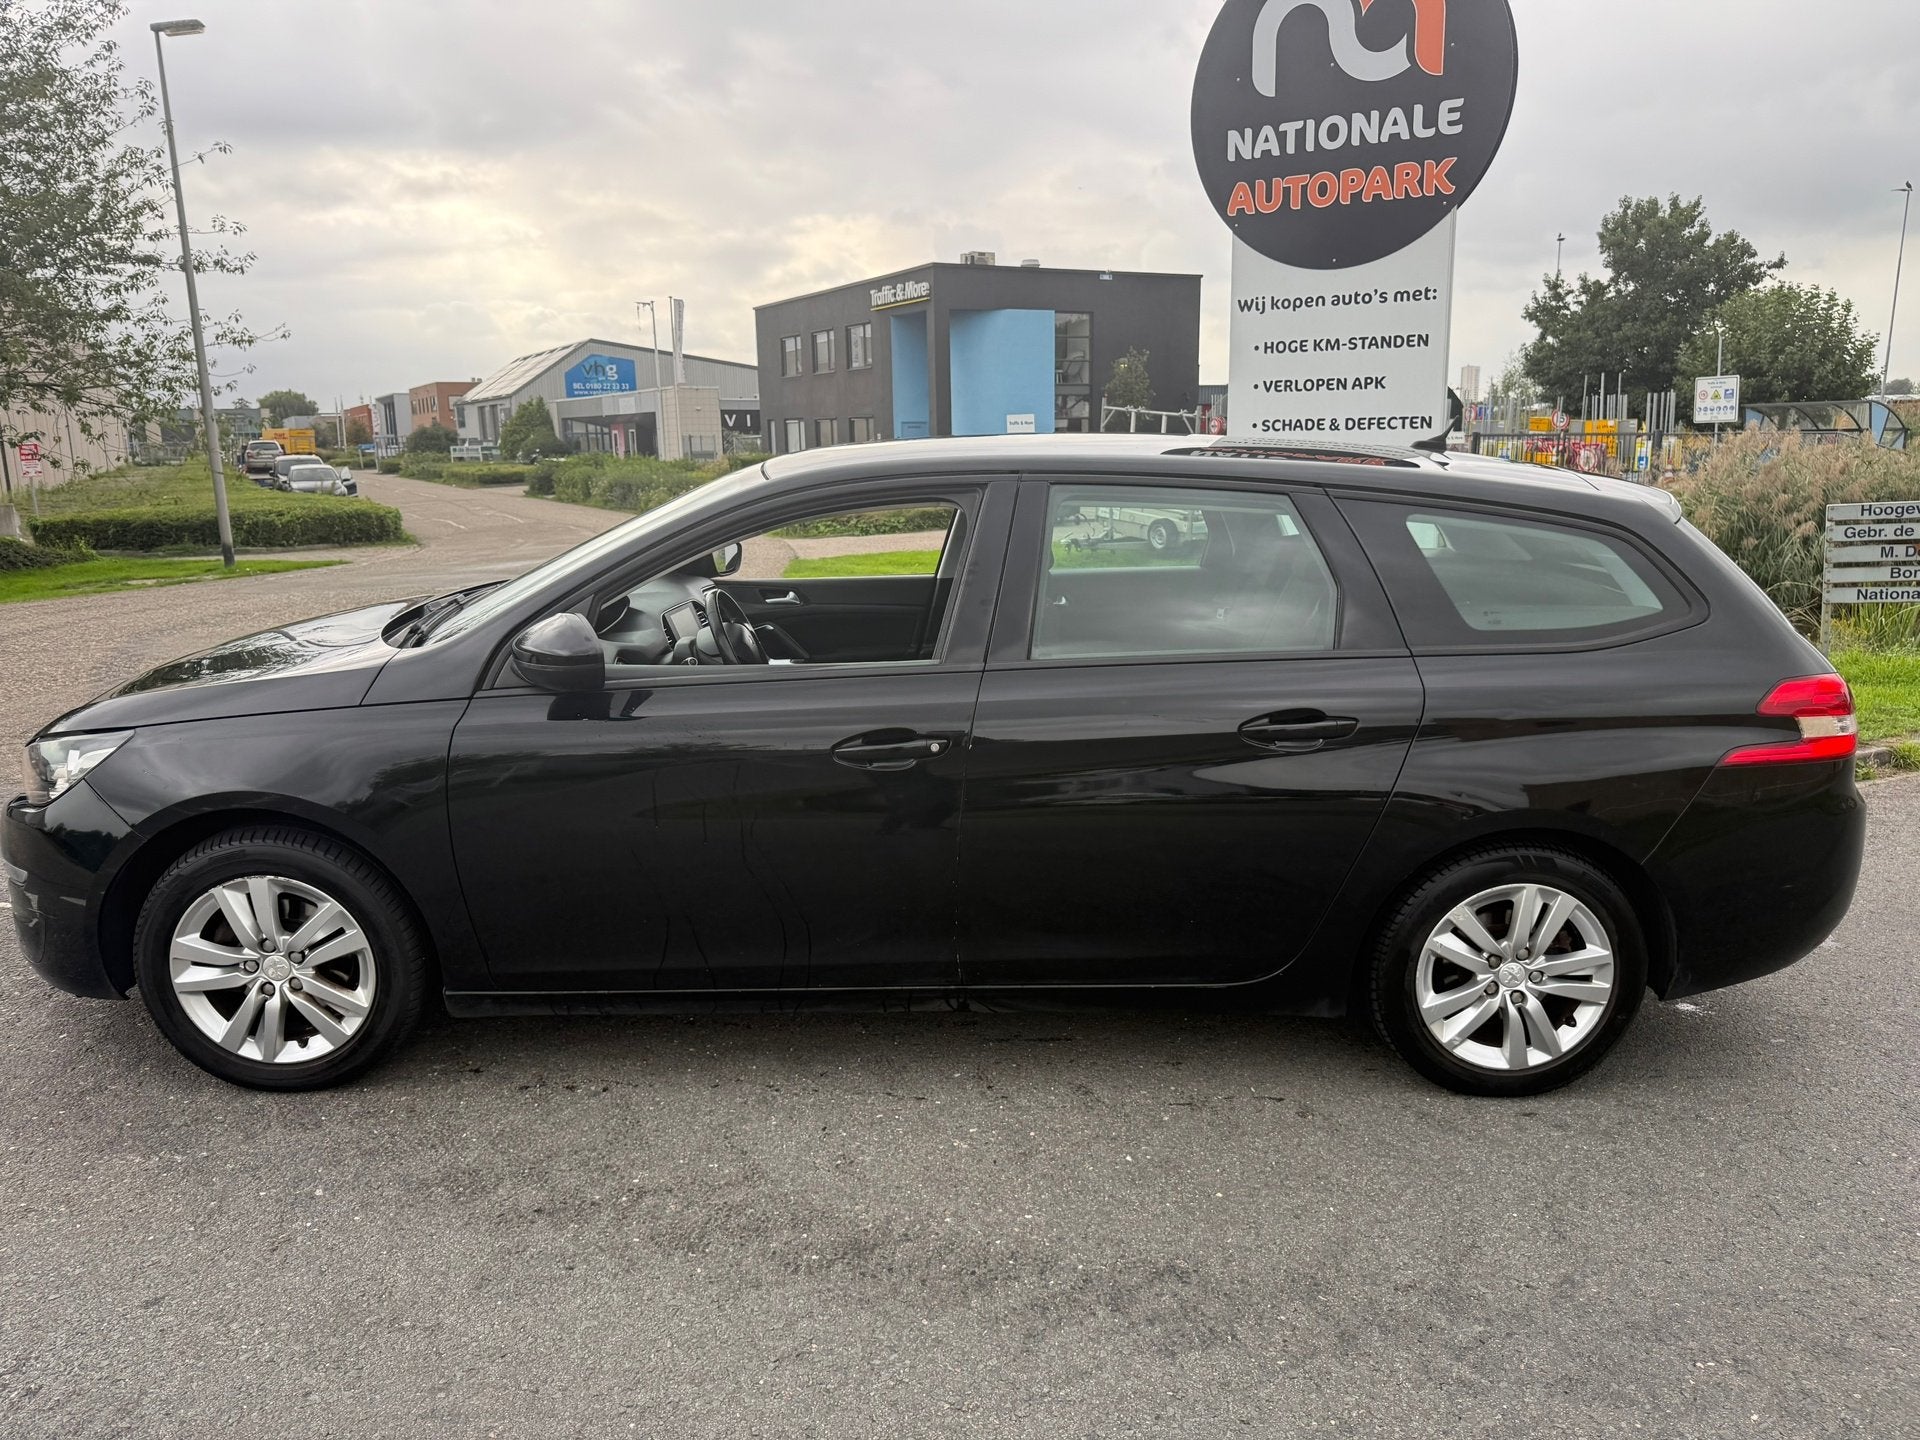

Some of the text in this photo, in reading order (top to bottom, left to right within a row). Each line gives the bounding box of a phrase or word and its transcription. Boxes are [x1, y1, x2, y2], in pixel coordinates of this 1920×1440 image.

[1227, 97, 1465, 162] NATIONALE
[1226, 157, 1458, 216] AUTOPARK
[870, 281, 930, 306] Traffic & More
[1237, 286, 1438, 315] Wij kopen auto's met:
[1263, 333, 1430, 354] HOGE KM-STANDEN
[581, 360, 619, 380] vhg
[1263, 375, 1387, 393] VERLOPEN APK
[1261, 416, 1433, 432] SCHADE & DEFECTEN
[1844, 525, 1915, 538] Gebr. de
[1880, 546, 1899, 558] M.
[1856, 588, 1920, 601] Nationa
